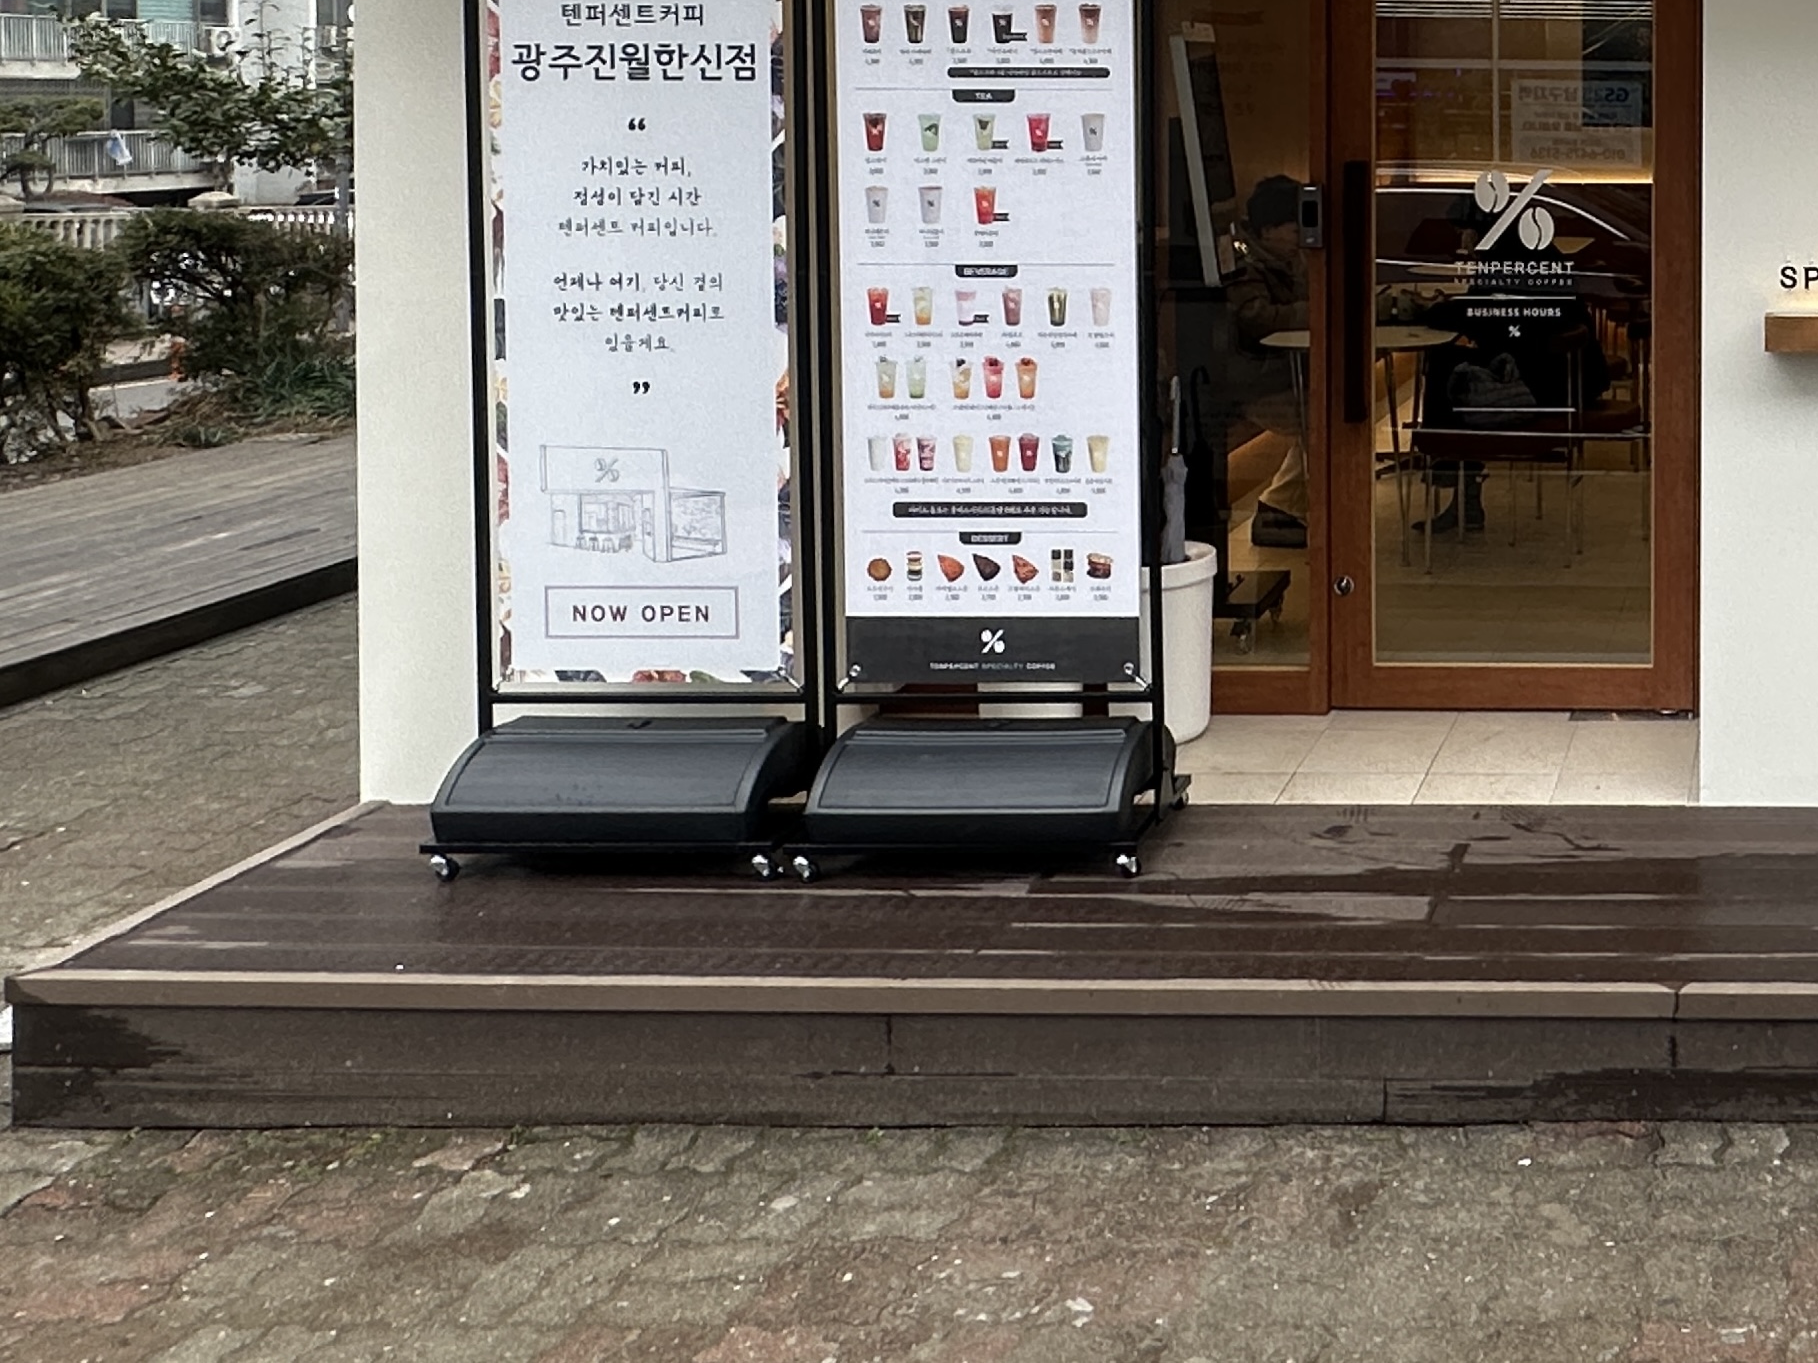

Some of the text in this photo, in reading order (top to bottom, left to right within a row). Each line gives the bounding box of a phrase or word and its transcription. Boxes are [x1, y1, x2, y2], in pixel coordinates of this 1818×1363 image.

[561, 3, 704, 27] 텐퍼센트커피
[511, 42, 757, 82] 광주진월한신점
[582, 156, 648, 177] 가치있는
[573, 187, 702, 206] 정성이 담긴 시간
[558, 217, 623, 237] 텐퍼센트
[1454, 261, 1575, 275] TENPERCENT
[553, 272, 603, 291] 언제나
[653, 272, 684, 291] 당신
[553, 302, 603, 322] 맛있는
[1523, 307, 1561, 317] HOURS
[573, 604, 710, 623] NOW OPEN
